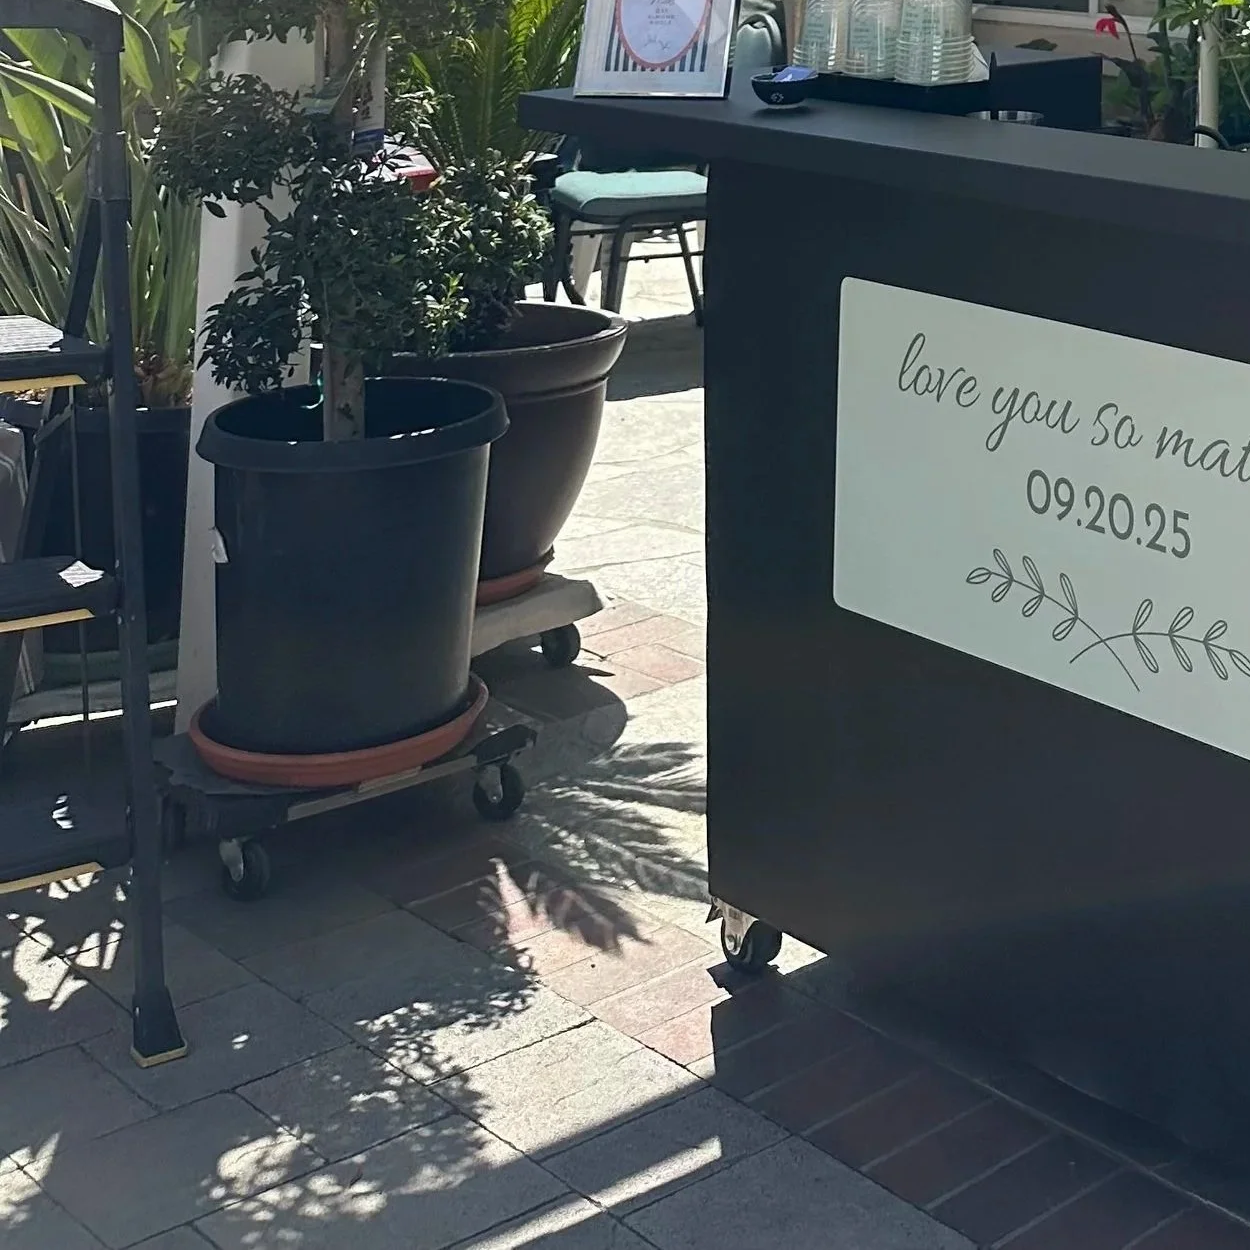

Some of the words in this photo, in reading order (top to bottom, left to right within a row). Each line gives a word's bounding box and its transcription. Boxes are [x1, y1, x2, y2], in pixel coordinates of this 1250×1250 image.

[897, 332, 981, 409] love
[985, 383, 1081, 453] you
[1090, 401, 1144, 448] so
[1025, 468, 1193, 559] 09.20.25
